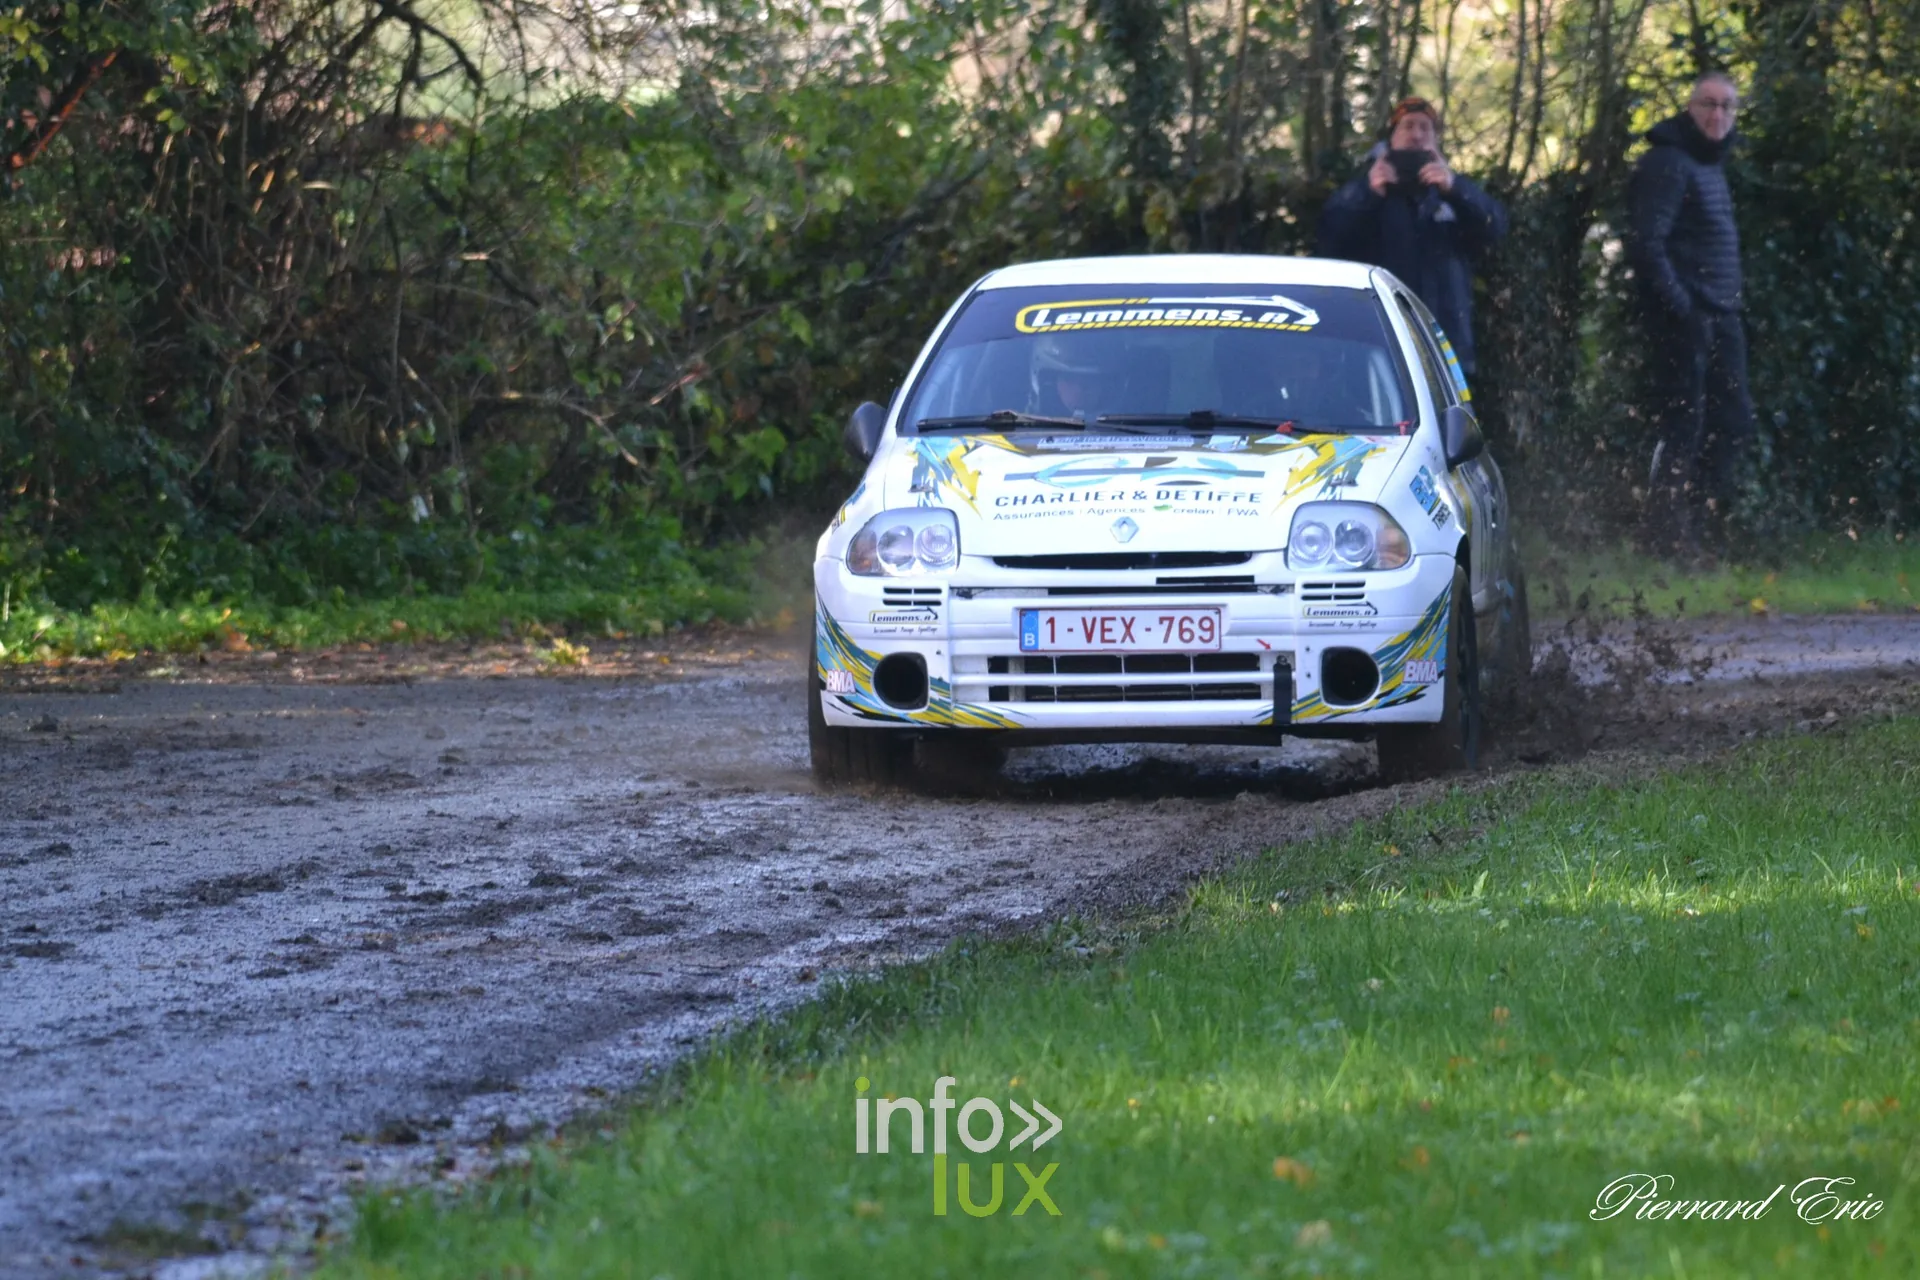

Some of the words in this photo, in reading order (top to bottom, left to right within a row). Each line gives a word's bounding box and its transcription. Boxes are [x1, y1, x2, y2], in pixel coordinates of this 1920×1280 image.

[994, 490, 1126, 507] CHARLIER
[1132, 490, 1147, 501] &
[1155, 489, 1263, 503] DETIFFE
[993, 508, 1075, 521] Assurances
[1087, 507, 1146, 516] Agences
[1173, 507, 1215, 516] crelan
[1024, 633, 1035, 646] B
[1402, 659, 1438, 684] BMA
[826, 668, 857, 694] BMA
